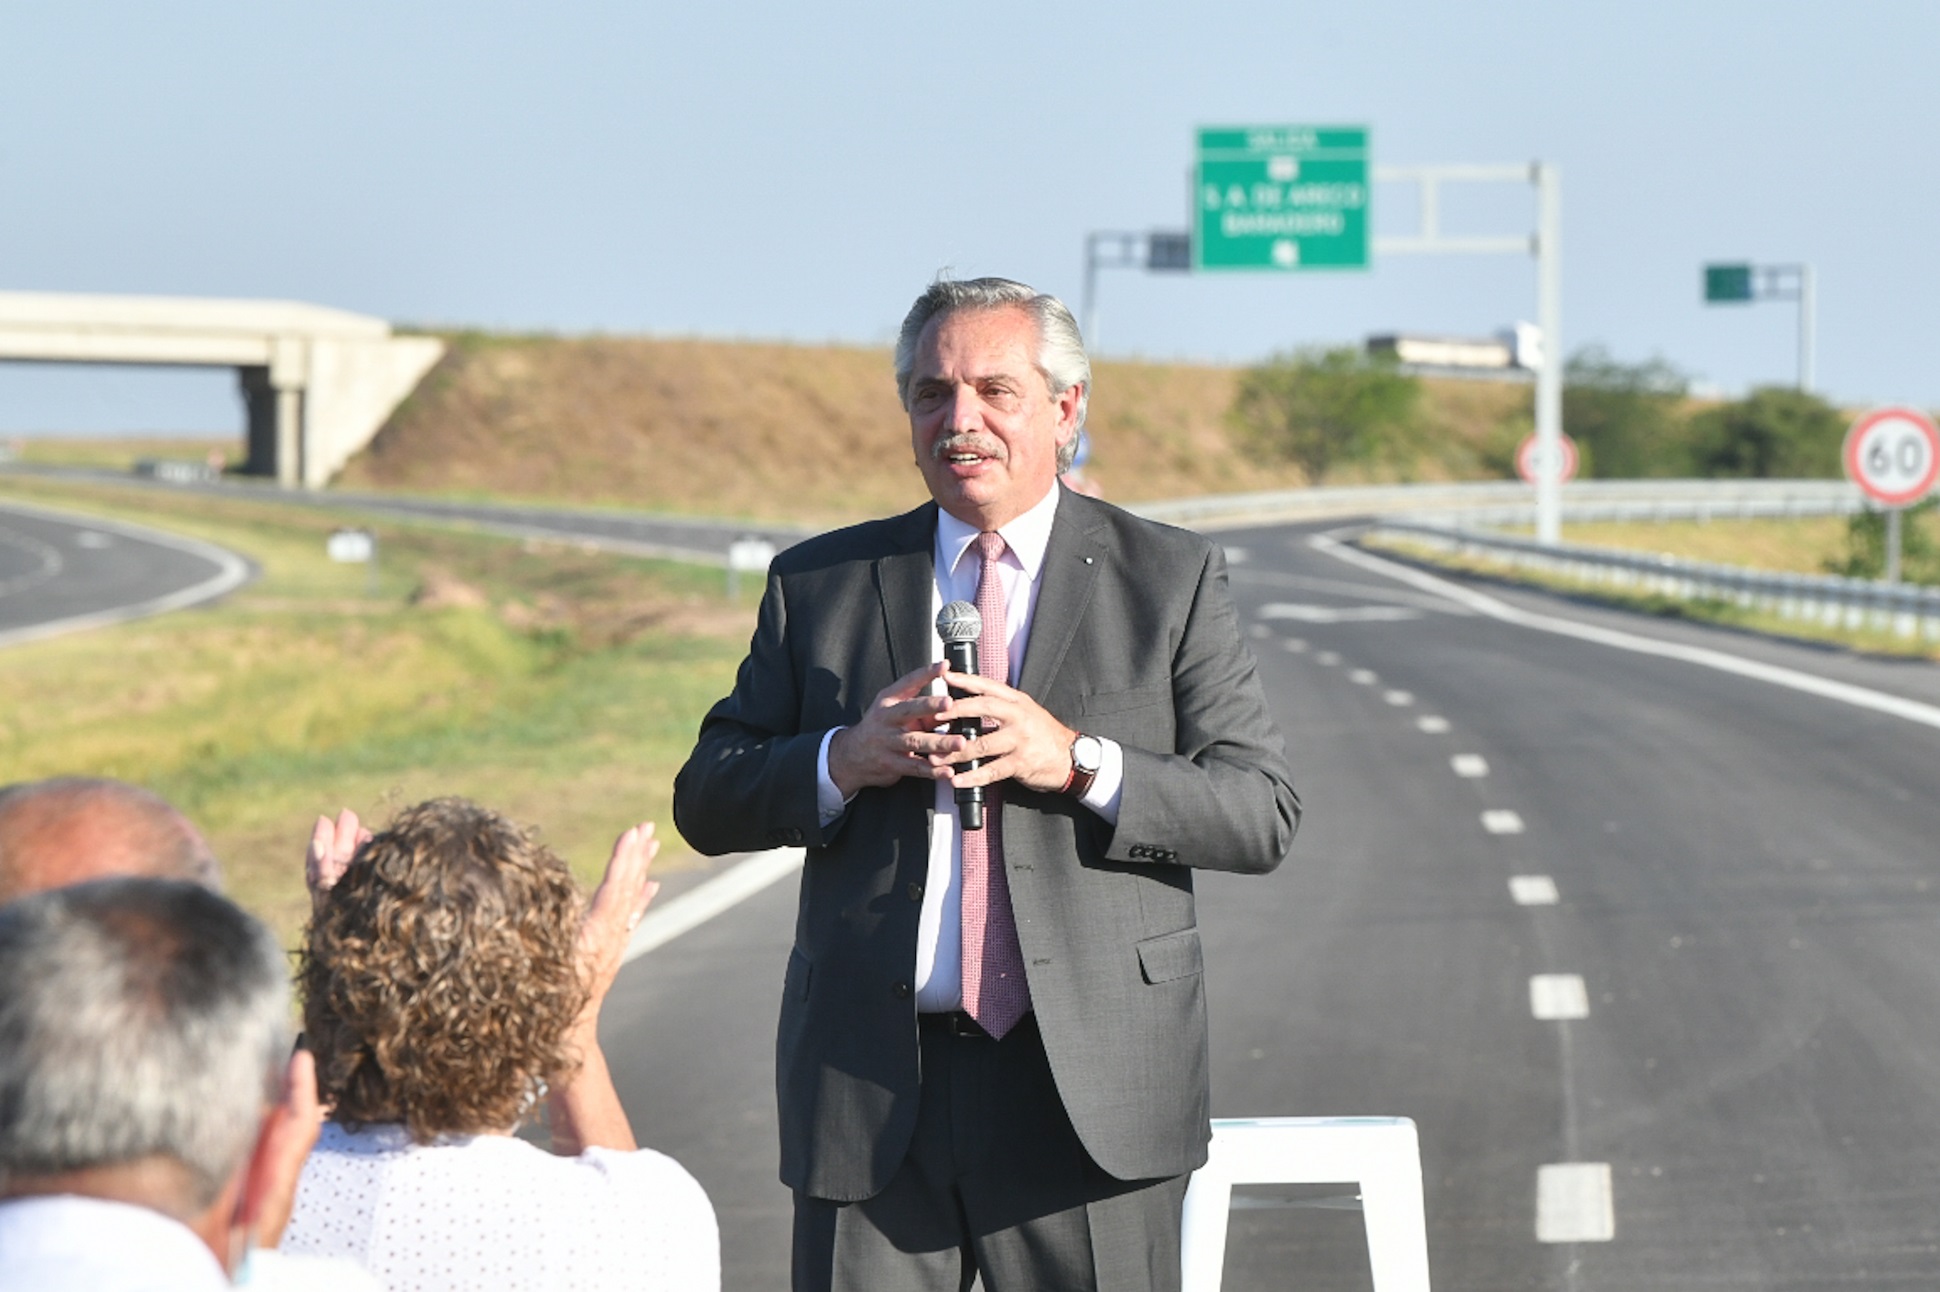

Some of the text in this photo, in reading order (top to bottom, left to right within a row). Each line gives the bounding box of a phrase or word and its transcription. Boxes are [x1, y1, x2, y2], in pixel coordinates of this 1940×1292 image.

[1253, 184, 1281, 208] DE
[1287, 184, 1364, 208] ARECO
[1867, 436, 1923, 478] 60
